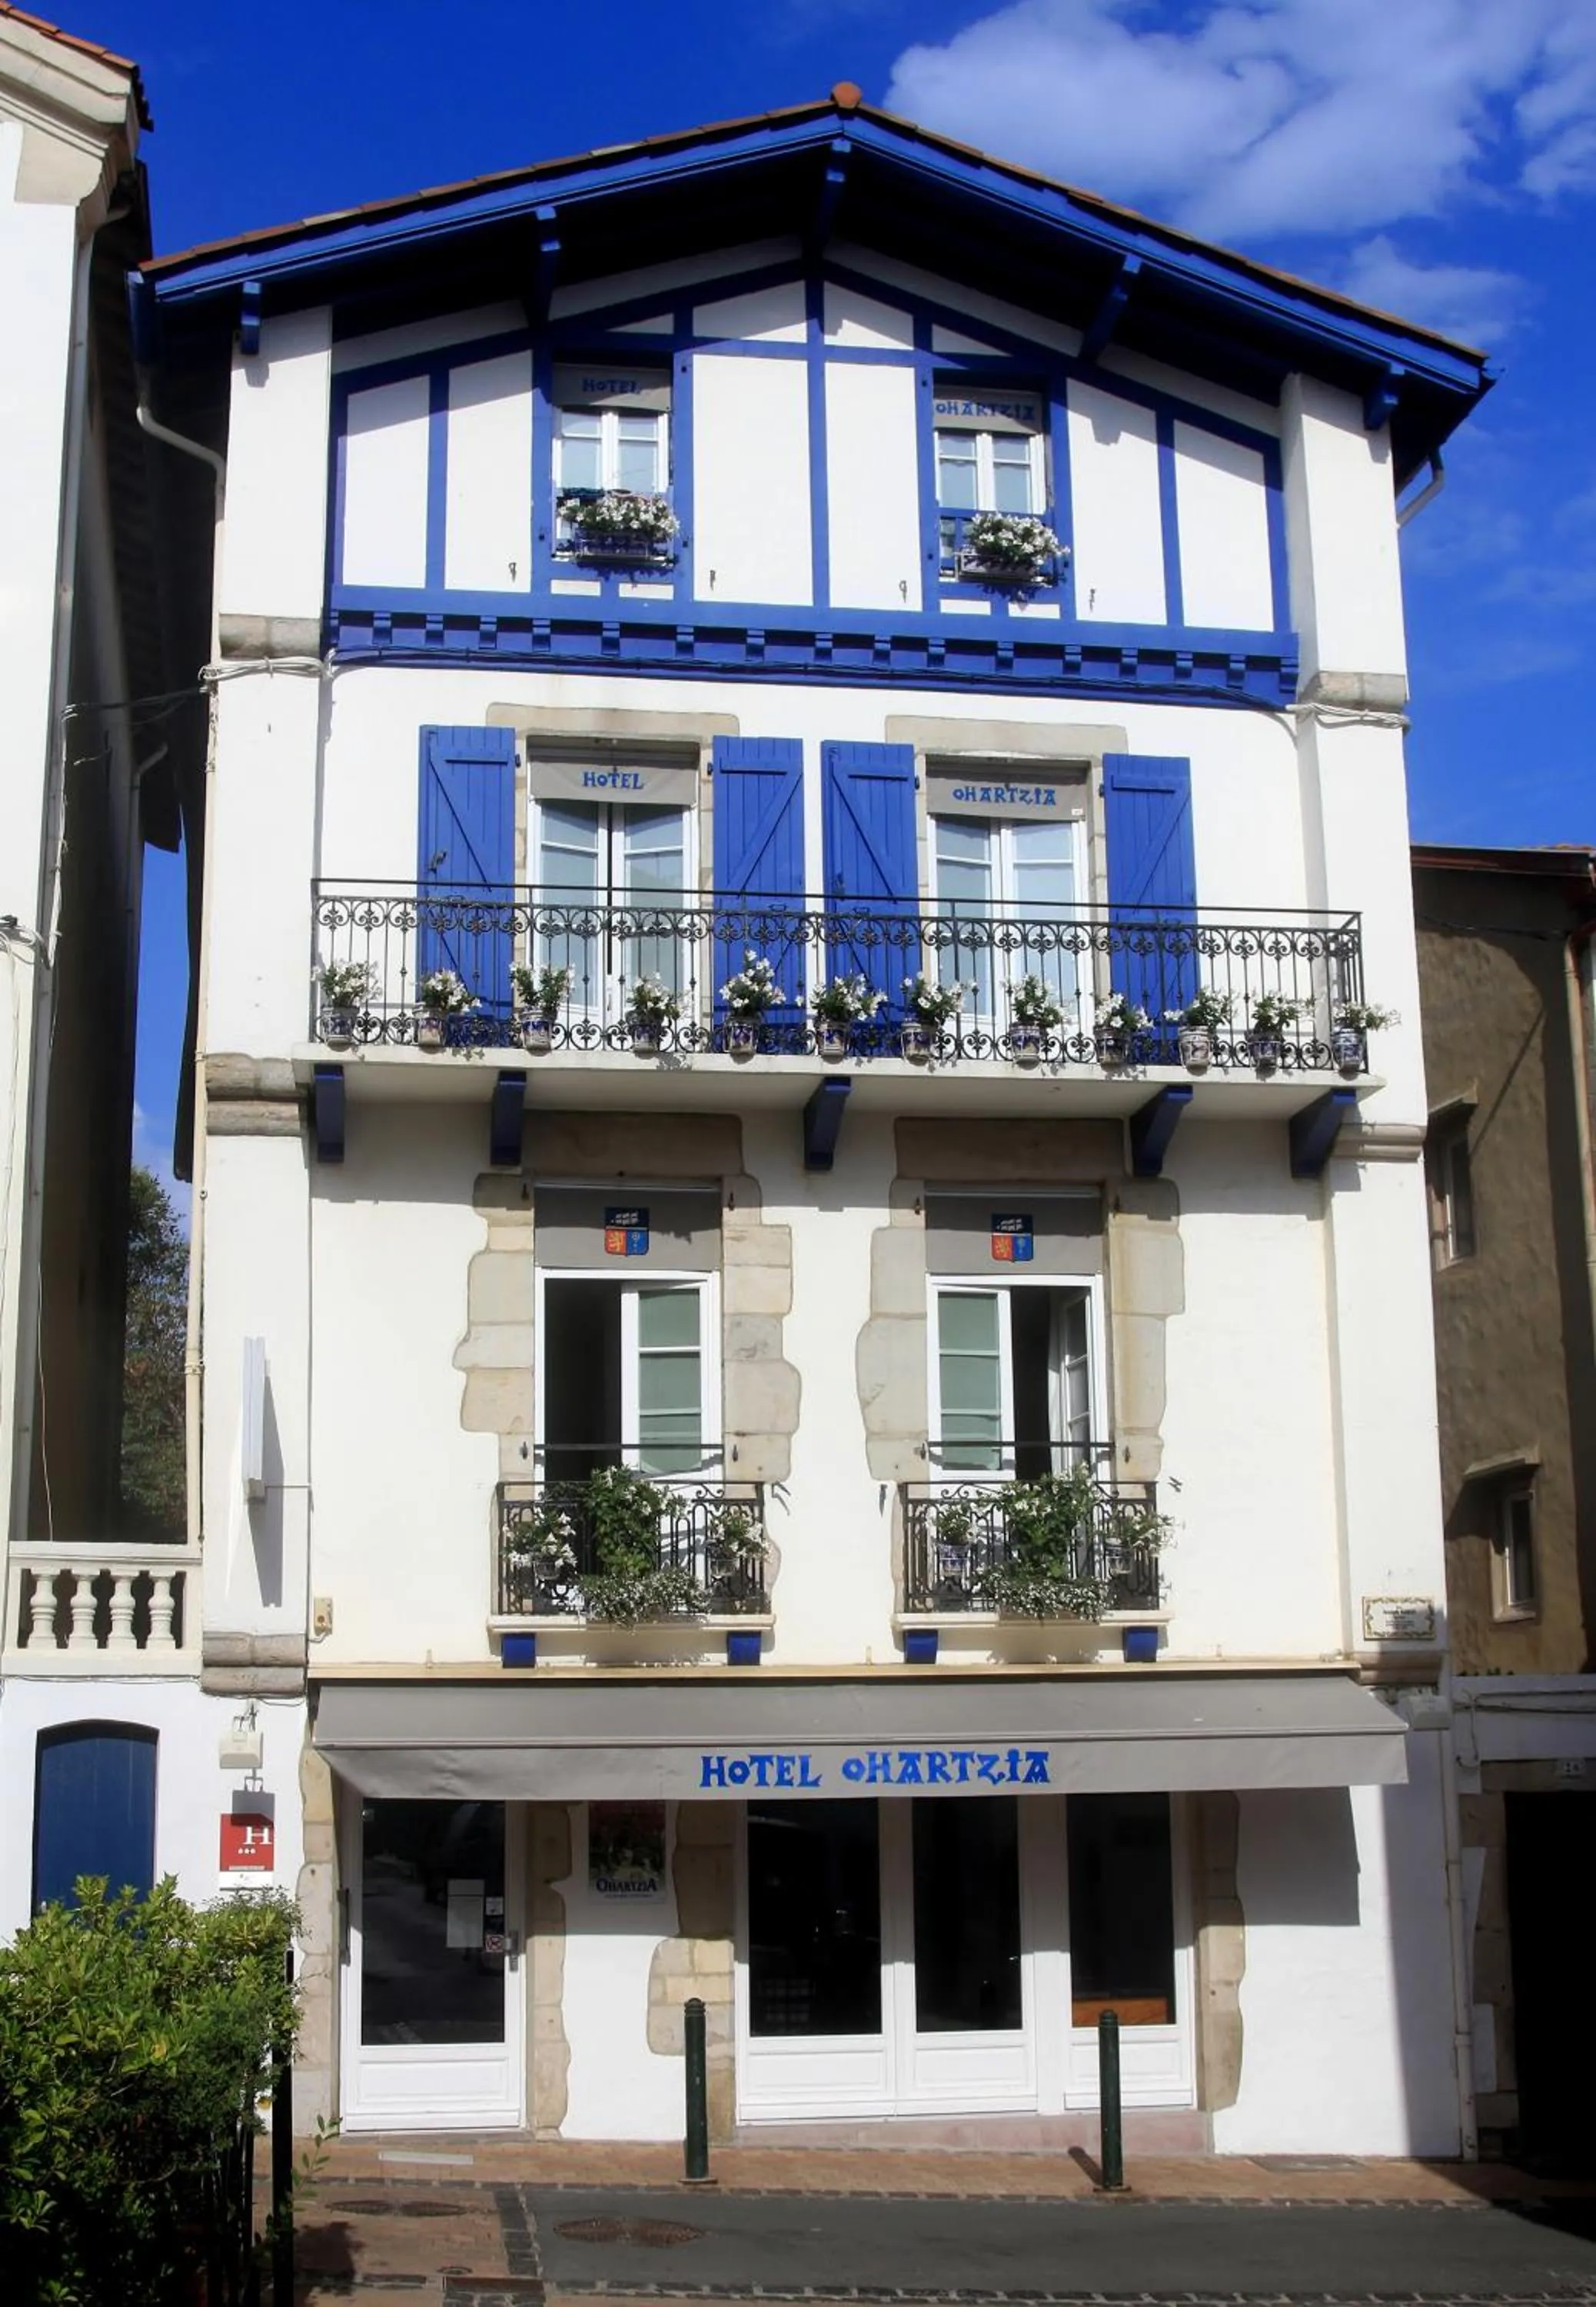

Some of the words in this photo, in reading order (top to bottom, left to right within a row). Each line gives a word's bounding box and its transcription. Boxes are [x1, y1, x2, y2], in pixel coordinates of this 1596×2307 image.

[583, 378, 640, 394] HOTEL
[582, 771, 645, 790] HOTEL
[952, 786, 1057, 806] OHARTZIA
[699, 1753, 823, 1788] HOTEL
[842, 1748, 1051, 1786] OHARTZIA
